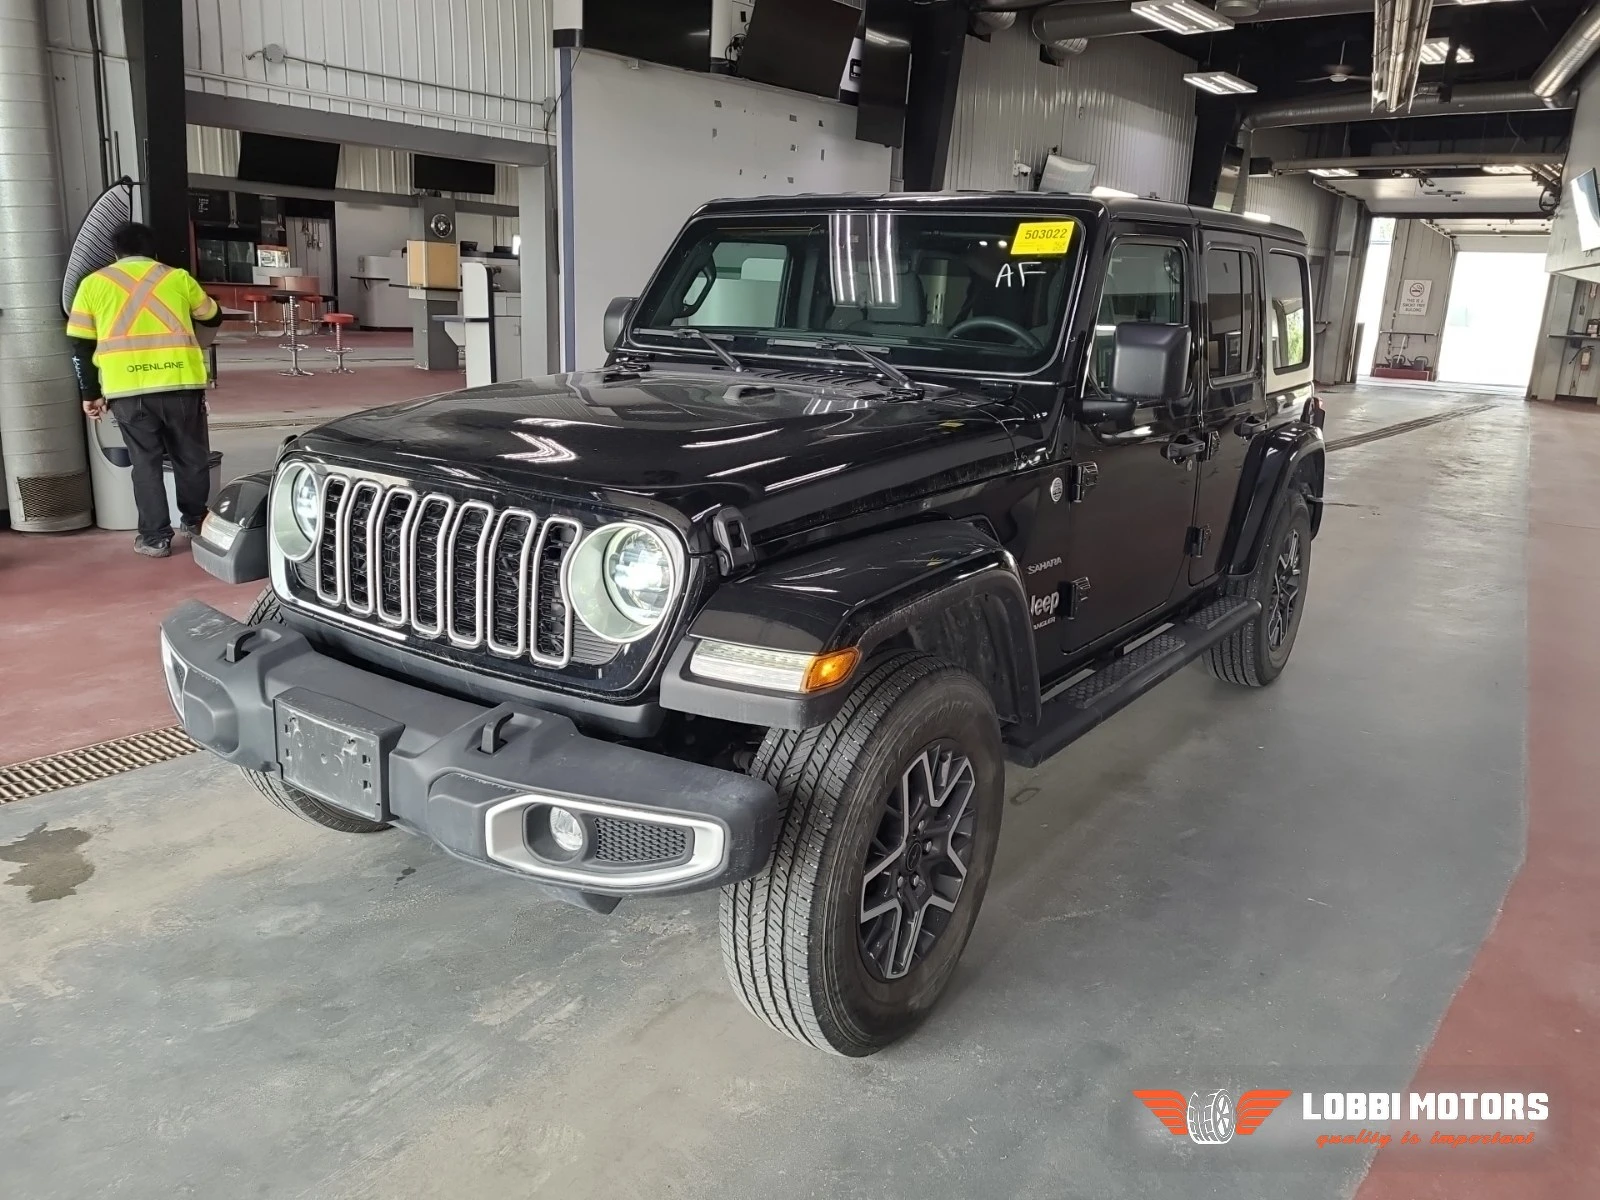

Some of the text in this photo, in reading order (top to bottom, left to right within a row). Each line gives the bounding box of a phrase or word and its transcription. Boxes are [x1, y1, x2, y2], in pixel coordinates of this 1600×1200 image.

[1024, 229, 1068, 240] 503022
[126, 361, 185, 373] OPENLANE
[1027, 556, 1062, 574] SAHARA
[1030, 591, 1060, 616] Jeep
